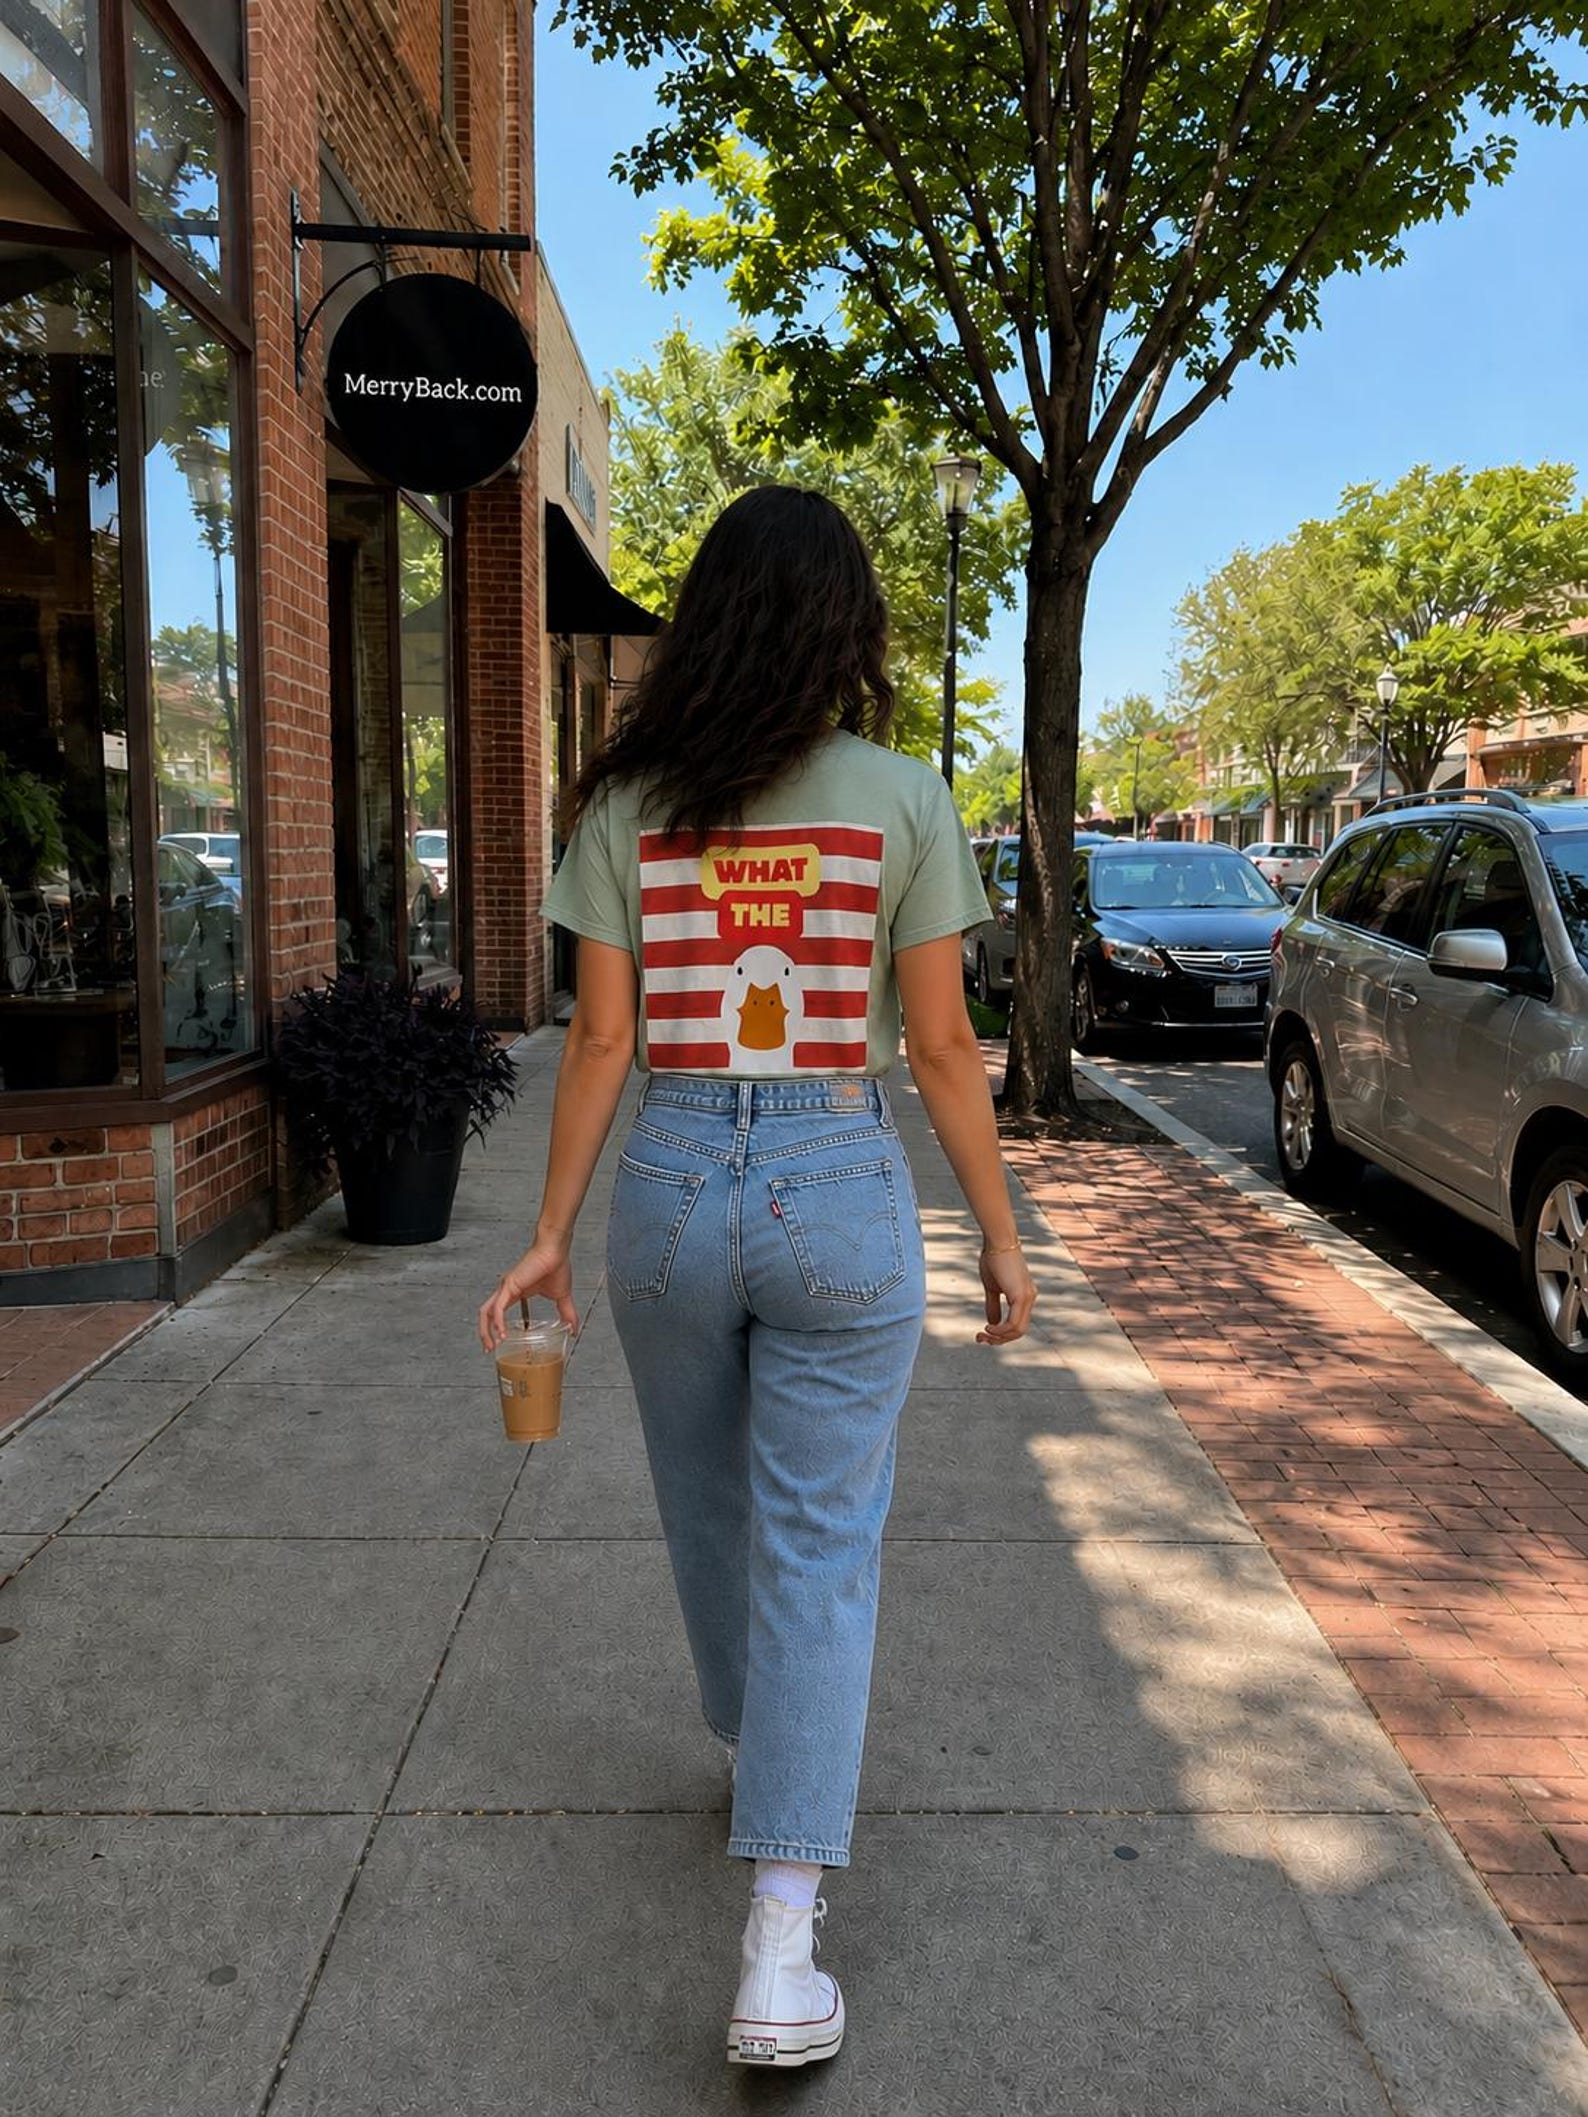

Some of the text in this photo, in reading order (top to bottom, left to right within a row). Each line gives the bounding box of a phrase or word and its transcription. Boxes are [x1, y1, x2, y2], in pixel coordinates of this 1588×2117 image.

[344, 373, 522, 403] MerryBack.com
[713, 857, 808, 883] WHAT
[730, 903, 790, 927] THE
